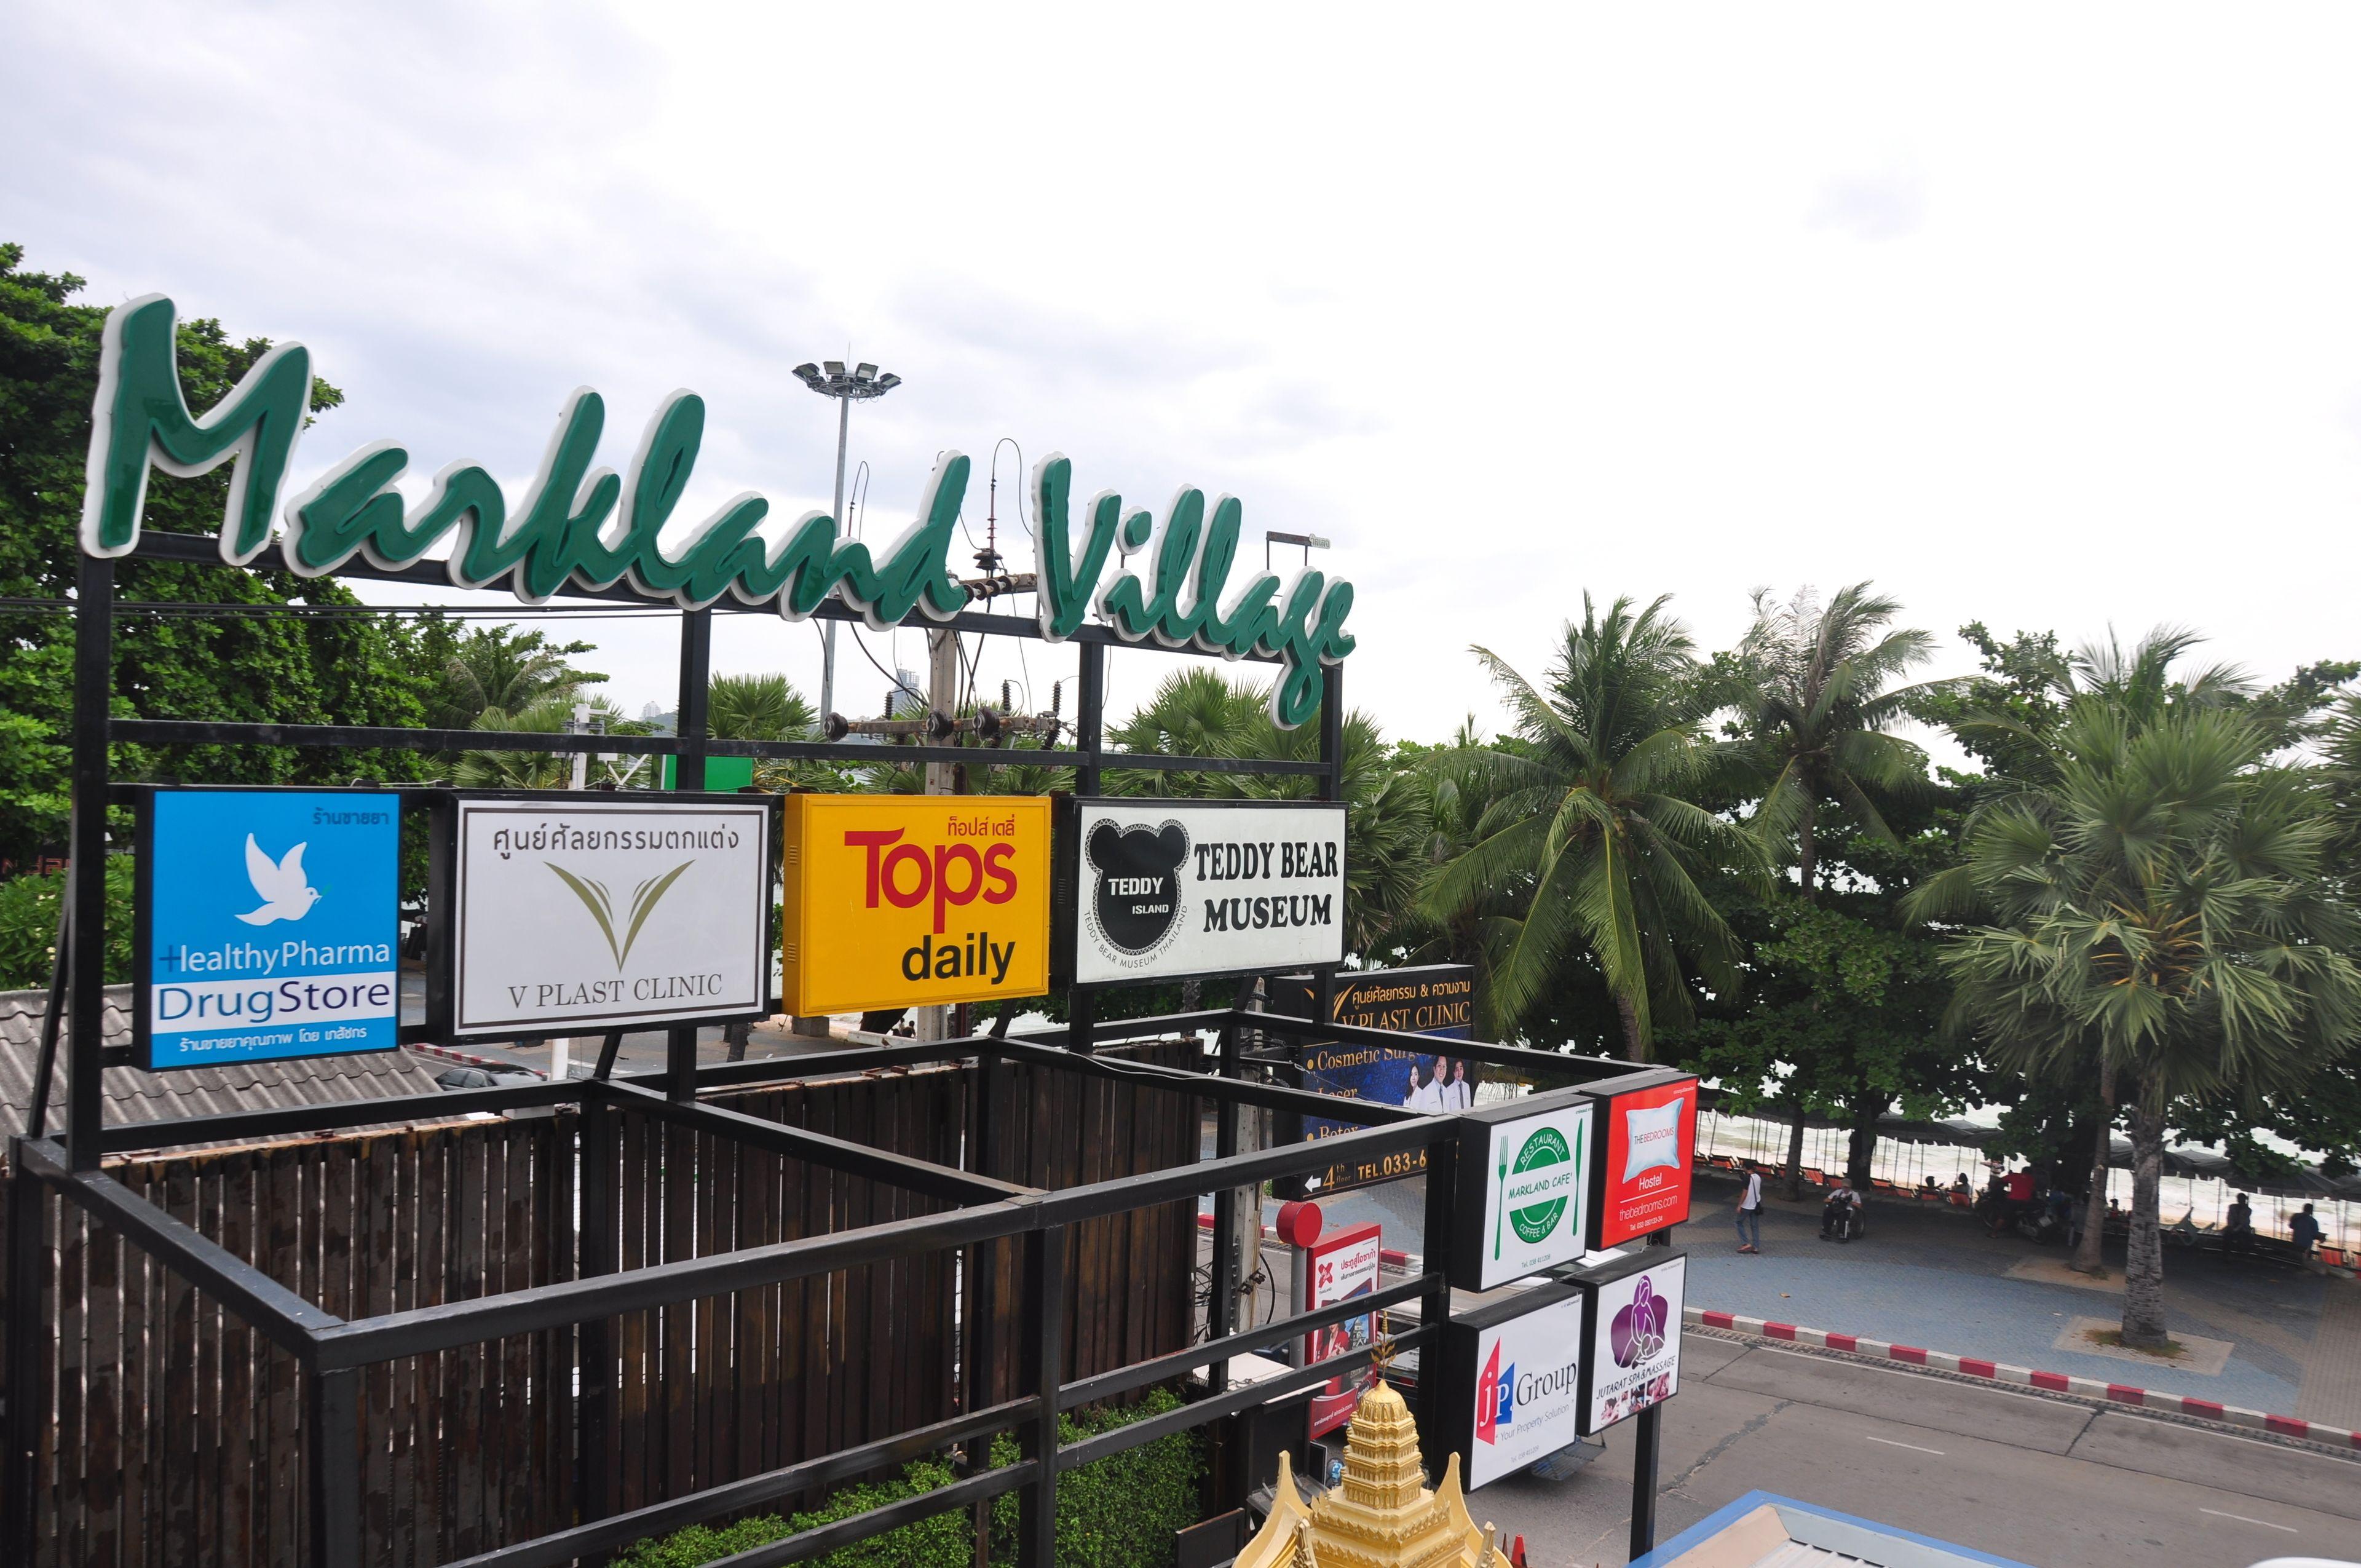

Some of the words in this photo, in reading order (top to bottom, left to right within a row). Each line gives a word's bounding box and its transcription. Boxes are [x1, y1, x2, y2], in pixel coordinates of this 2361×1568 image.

[82, 293, 968, 632] Markland
[1032, 450, 1356, 731] Village
[314, 807, 389, 825] ร้านขายยา
[947, 816, 989, 836] ท็อปส์
[1194, 842, 1275, 881] TEDDY
[1281, 841, 1339, 879] BEAR
[844, 826, 1018, 934] Tops
[1108, 877, 1164, 895] TEDDY
[1132, 904, 1169, 914] ISLAND
[1203, 893, 1332, 933] MUSEUM
[1084, 910, 1099, 943] TEDDY
[1099, 944, 1117, 964] BEAR
[1120, 954, 1158, 968] MUSEUM
[1158, 905, 1188, 955] THAILAND
[901, 932, 1016, 985] daily
[508, 986, 528, 1008] V
[536, 980, 625, 1007] PLAST
[633, 973, 722, 1000] CLINIC
[1353, 985, 1417, 1010] ศูนย์ศัลยกรรม
[1420, 984, 1428, 997] &
[1433, 981, 1471, 996] ความงาม
[1359, 1008, 1410, 1031] PLAST
[1416, 1001, 1470, 1028] CLINIC
[180, 1033, 293, 1051] ร้านขายยาคุณภาพ
[299, 1028, 320, 1042] โดย
[325, 1026, 367, 1040] เภสัชกร
[1317, 1047, 1380, 1071] Cosmetic
[1520, 1133, 1565, 1166] RESTAURANT
[1508, 1179, 1550, 1200] MARKLAND
[1639, 1173, 1662, 1191] Hostel
[1619, 1195, 1678, 1221] thebedrooms.com
[1519, 1223, 1541, 1238] COFFEE
[1541, 1225, 1546, 1234] &
[1546, 1213, 1559, 1230] BAR
[1516, 1362, 1577, 1406] Group
[1596, 1377, 1627, 1400] JUTARAT
[1516, 1416, 1543, 1434] Property
[1544, 1404, 1569, 1422] Solution
